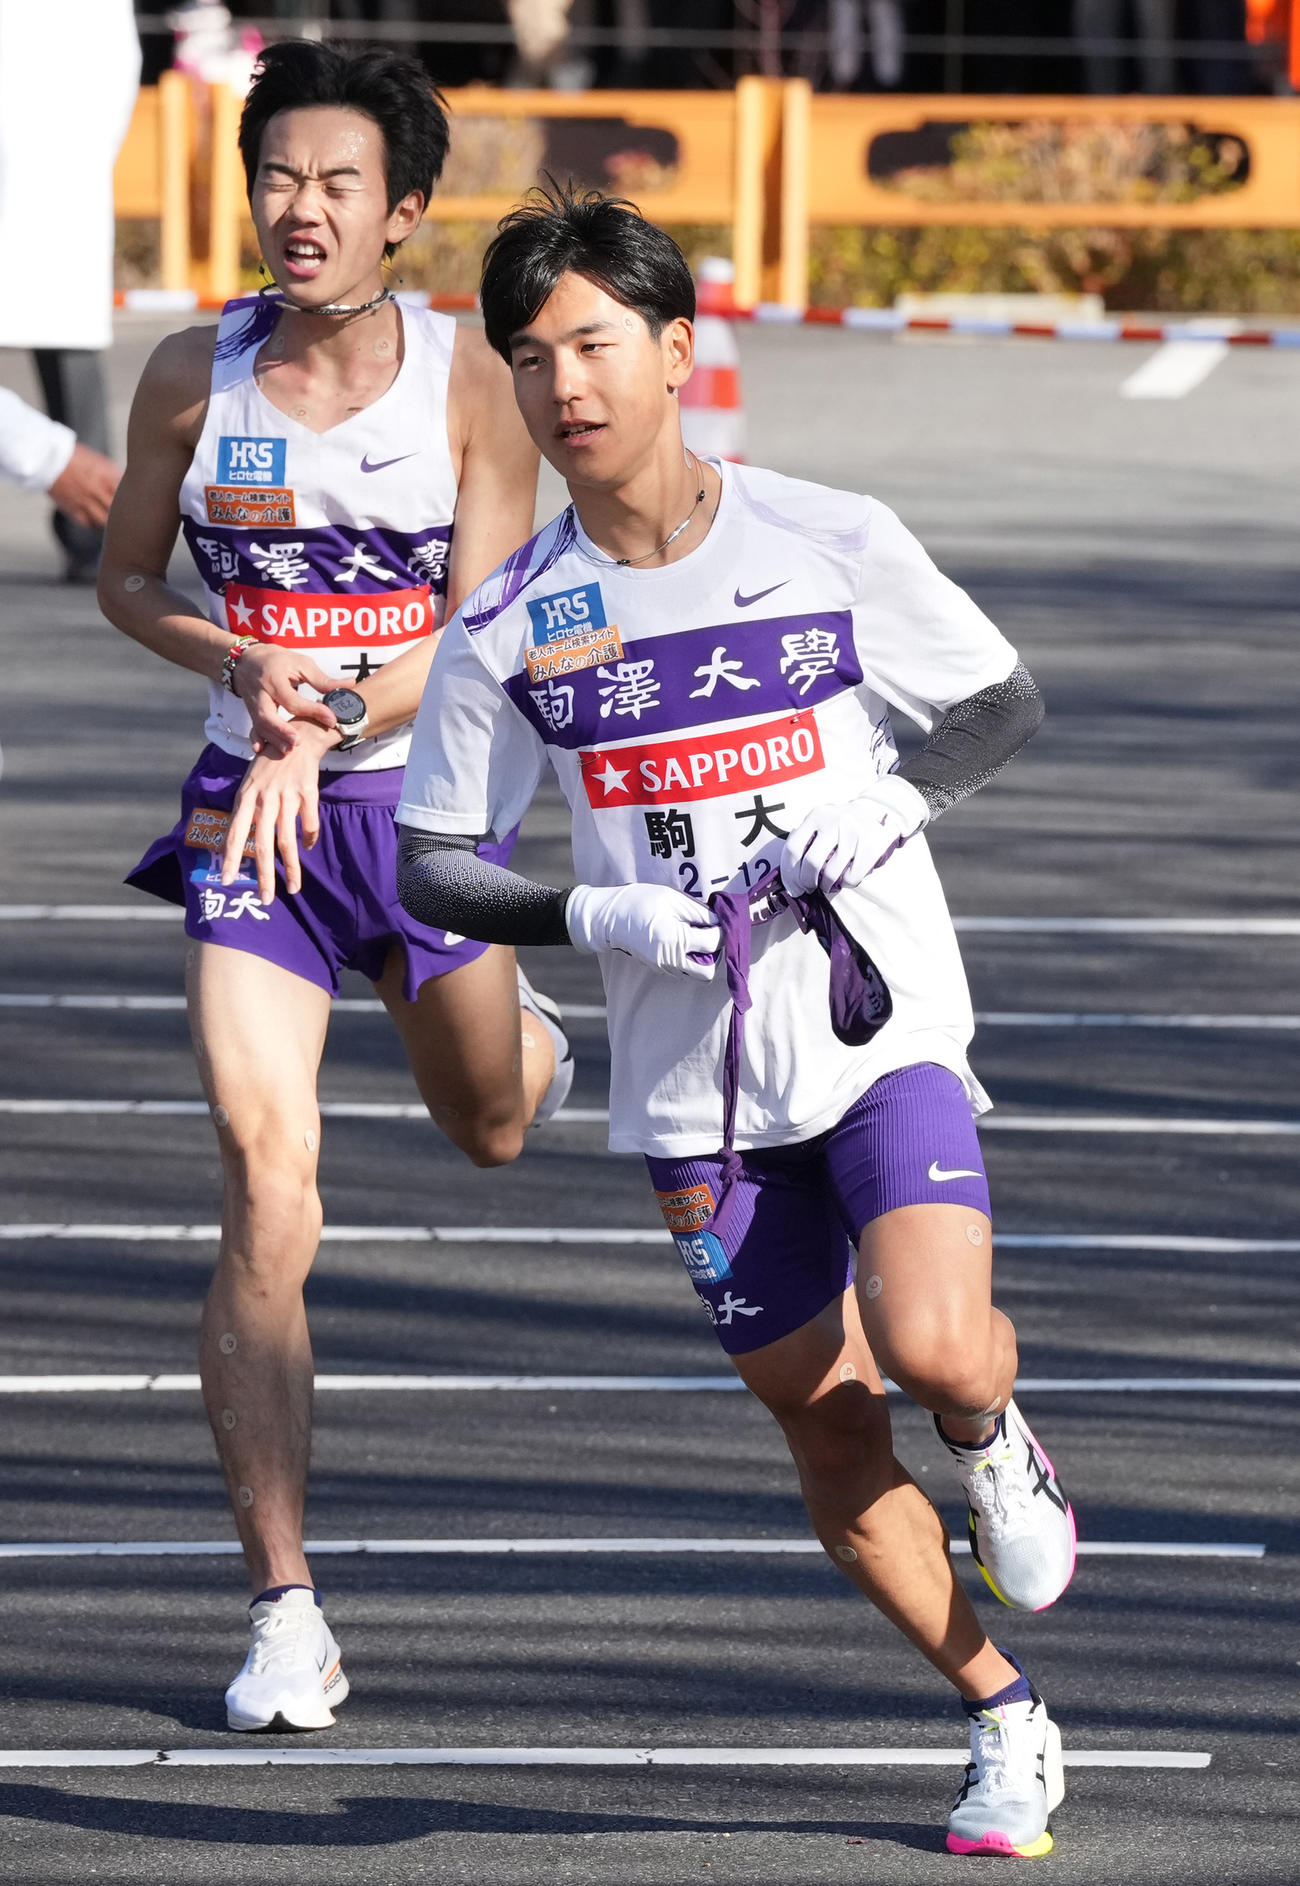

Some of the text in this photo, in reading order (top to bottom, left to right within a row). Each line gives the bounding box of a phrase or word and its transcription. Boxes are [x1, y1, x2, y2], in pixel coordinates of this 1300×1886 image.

[229, 441, 274, 468] HRS
[210, 505, 292, 522] みんなの介護
[261, 602, 425, 637] SAPPORO
[541, 591, 590, 629] HRS
[528, 628, 615, 661] 老人ホーム検索サイト
[532, 642, 619, 681] みんなの介護
[641, 728, 814, 792] SAPPORO
